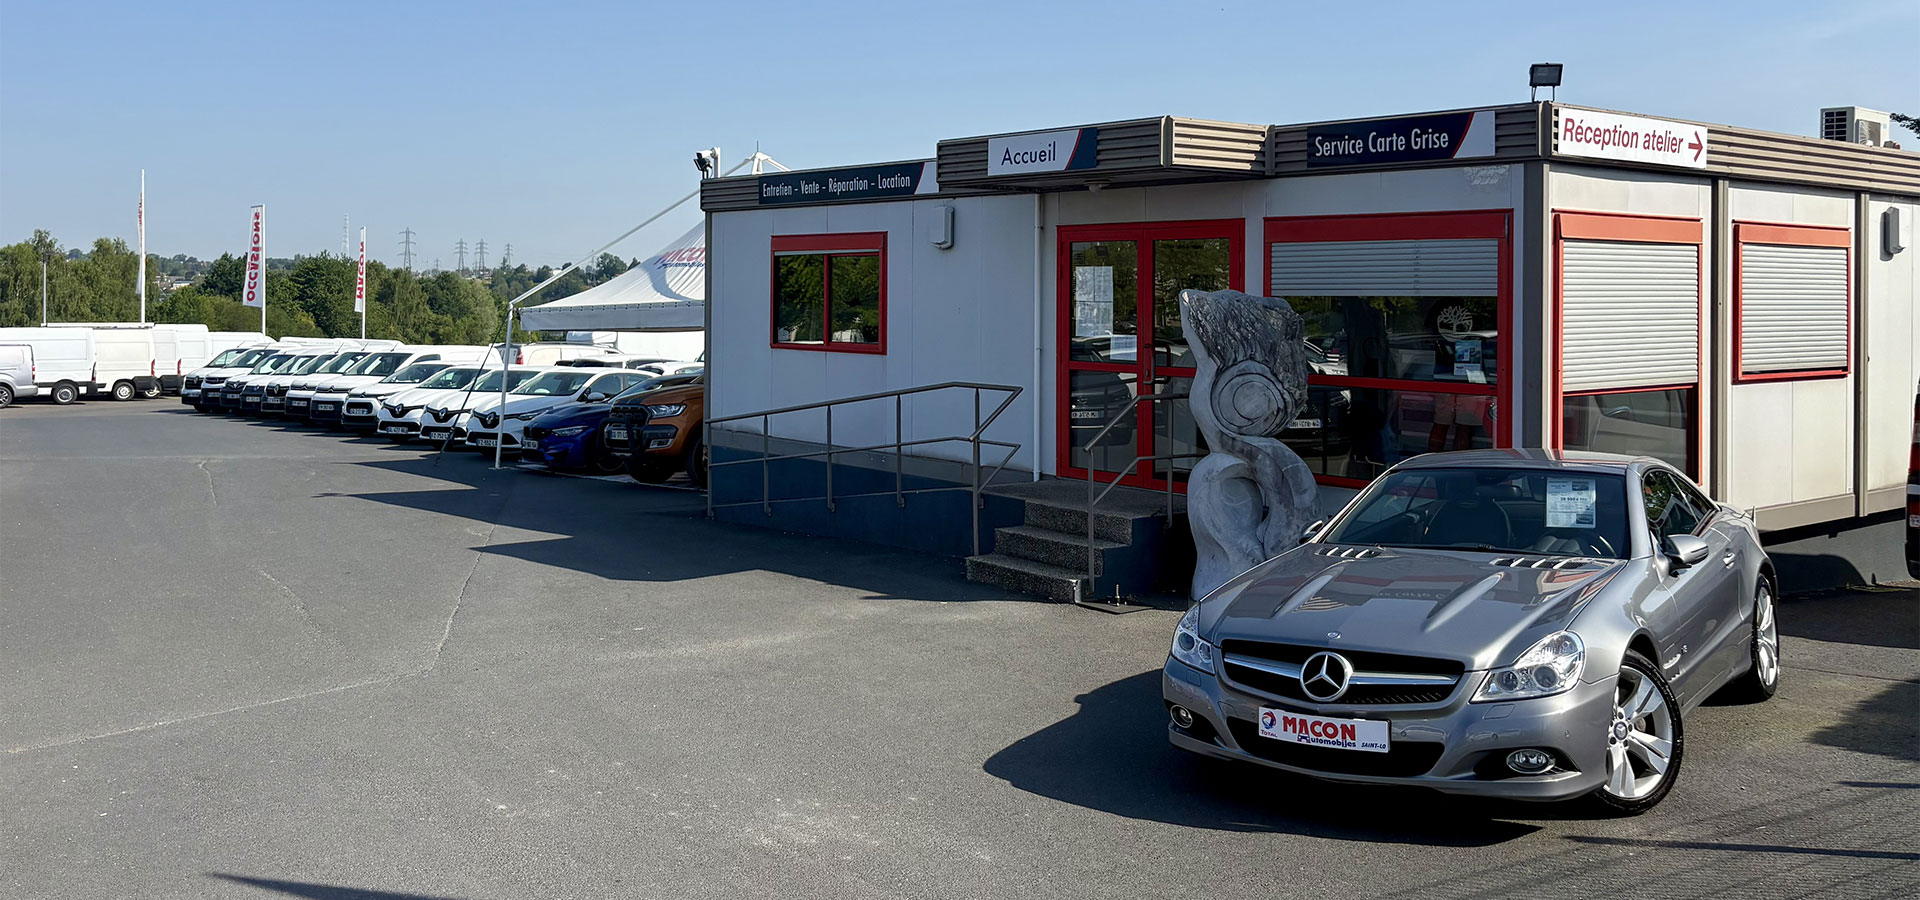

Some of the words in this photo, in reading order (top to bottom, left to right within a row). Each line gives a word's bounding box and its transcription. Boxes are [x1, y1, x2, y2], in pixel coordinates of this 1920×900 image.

[1315, 135, 1364, 157] Service
[1368, 131, 1406, 153] Carte
[1411, 128, 1449, 150] Grise
[1563, 117, 1639, 151] Réception
[1643, 129, 1684, 154] atelier
[1001, 140, 1056, 166] Accueil
[763, 182, 793, 198] Entretien
[800, 179, 820, 195] Vente
[828, 176, 869, 196] Réparation
[878, 173, 911, 190] Location
[1260, 729, 1278, 738] TOTAL
[1282, 715, 1356, 741] MACON
